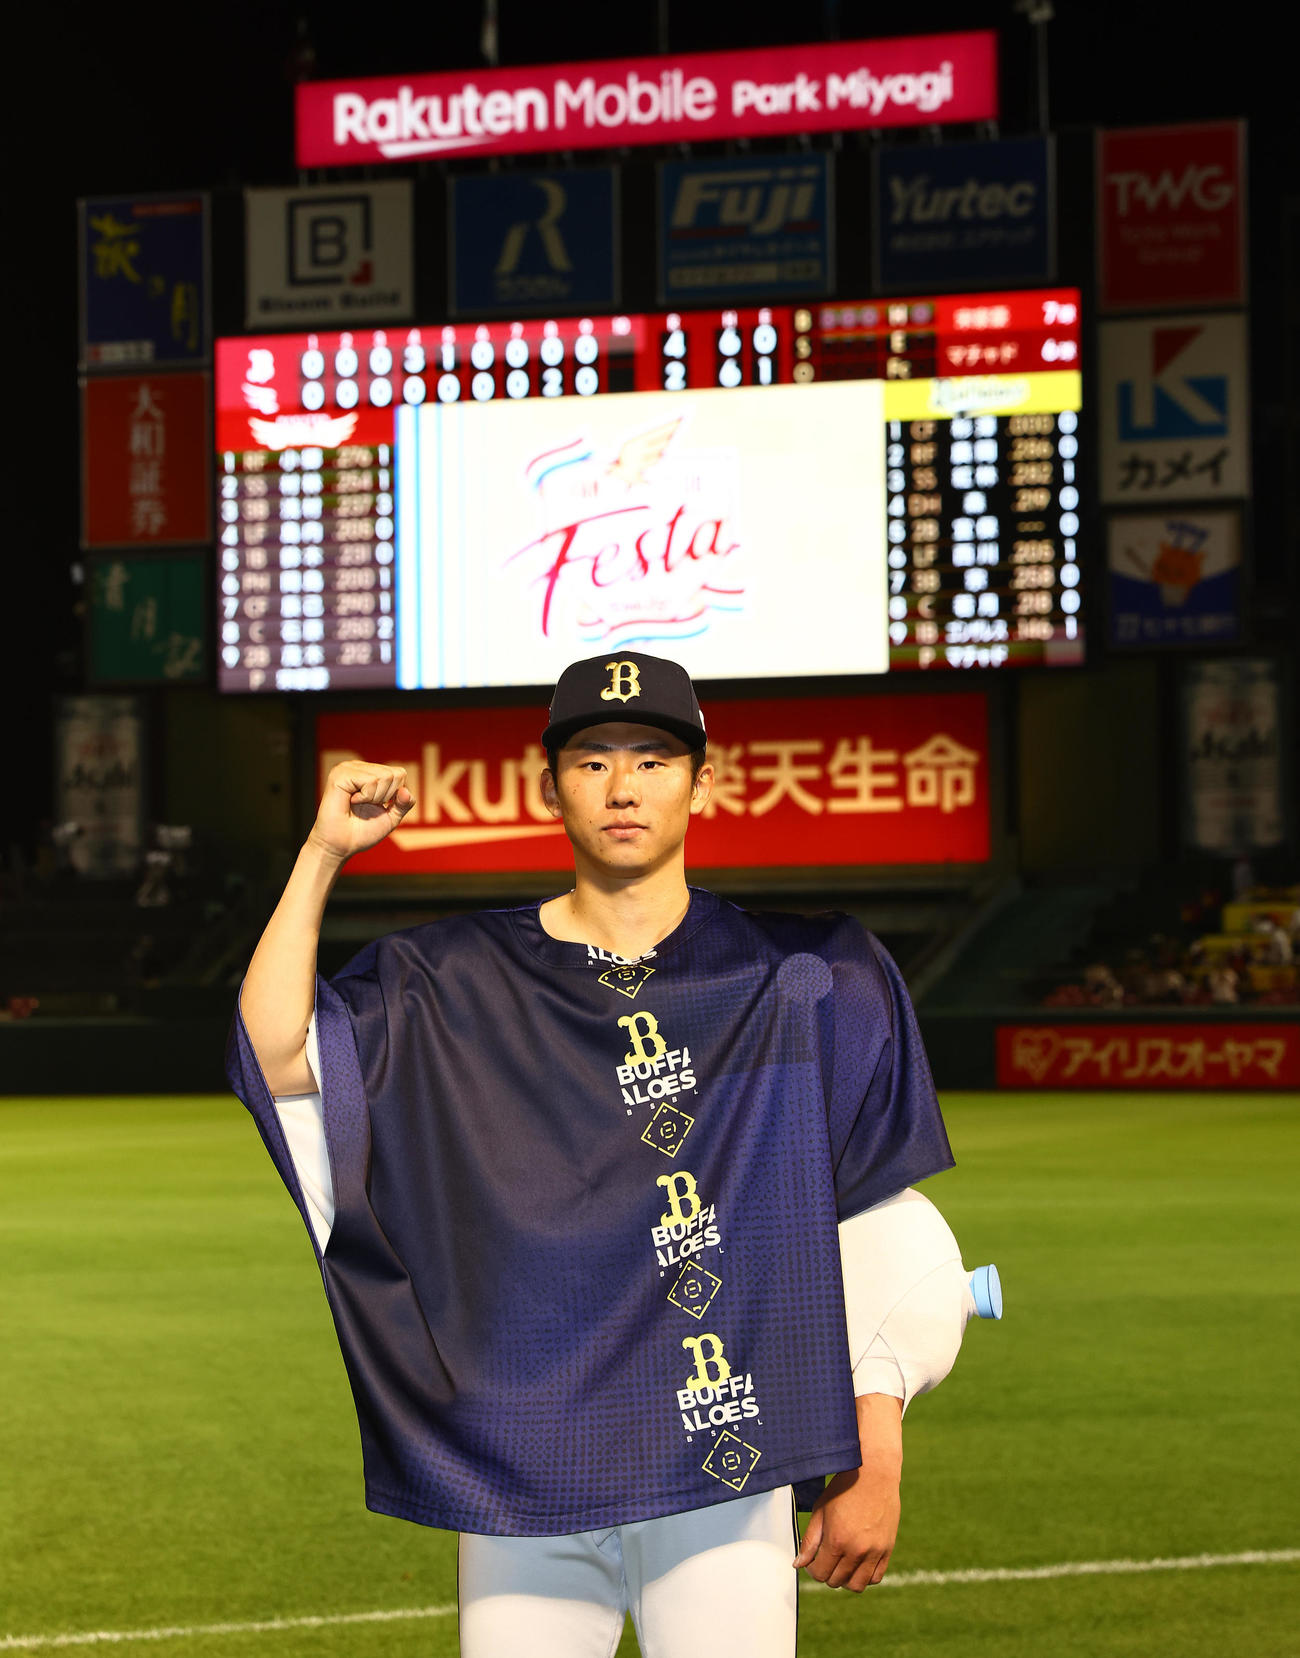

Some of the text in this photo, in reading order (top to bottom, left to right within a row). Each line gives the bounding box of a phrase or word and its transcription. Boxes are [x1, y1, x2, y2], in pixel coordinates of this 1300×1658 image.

[334, 60, 953, 146] Rakuten Mobile Park Miyagi
[670, 166, 819, 235] Fuji
[888, 174, 1036, 223] Yurtec
[1105, 160, 1234, 217] TWG
[310, 216, 348, 268] B
[495, 178, 574, 274] R
[302, 350, 324, 379] 0
[335, 348, 358, 377] 0
[369, 346, 392, 375] 0
[404, 345, 425, 373] 3
[441, 343, 455, 371] 1
[471, 340, 494, 370] 0
[506, 339, 528, 368] 0
[541, 336, 563, 366] 0
[575, 335, 598, 364] 0
[663, 330, 686, 358] 4
[753, 324, 777, 355] 0
[302, 381, 324, 410] 0
[335, 380, 358, 409] 0
[369, 378, 392, 407] 0
[403, 375, 426, 405] 0
[437, 374, 460, 403] 0
[472, 372, 495, 401] 0
[506, 370, 529, 399] 0
[542, 368, 562, 397] 2
[575, 367, 598, 396] 0
[664, 361, 686, 391] 2
[1118, 447, 1230, 491] カメイ
[502, 504, 740, 637] Festa
[601, 661, 642, 703] B
[617, 1011, 668, 1067] B
[1061, 1036, 1286, 1080] アイリスオーヤマ
[656, 1171, 701, 1228] B
[682, 1333, 731, 1391] B
